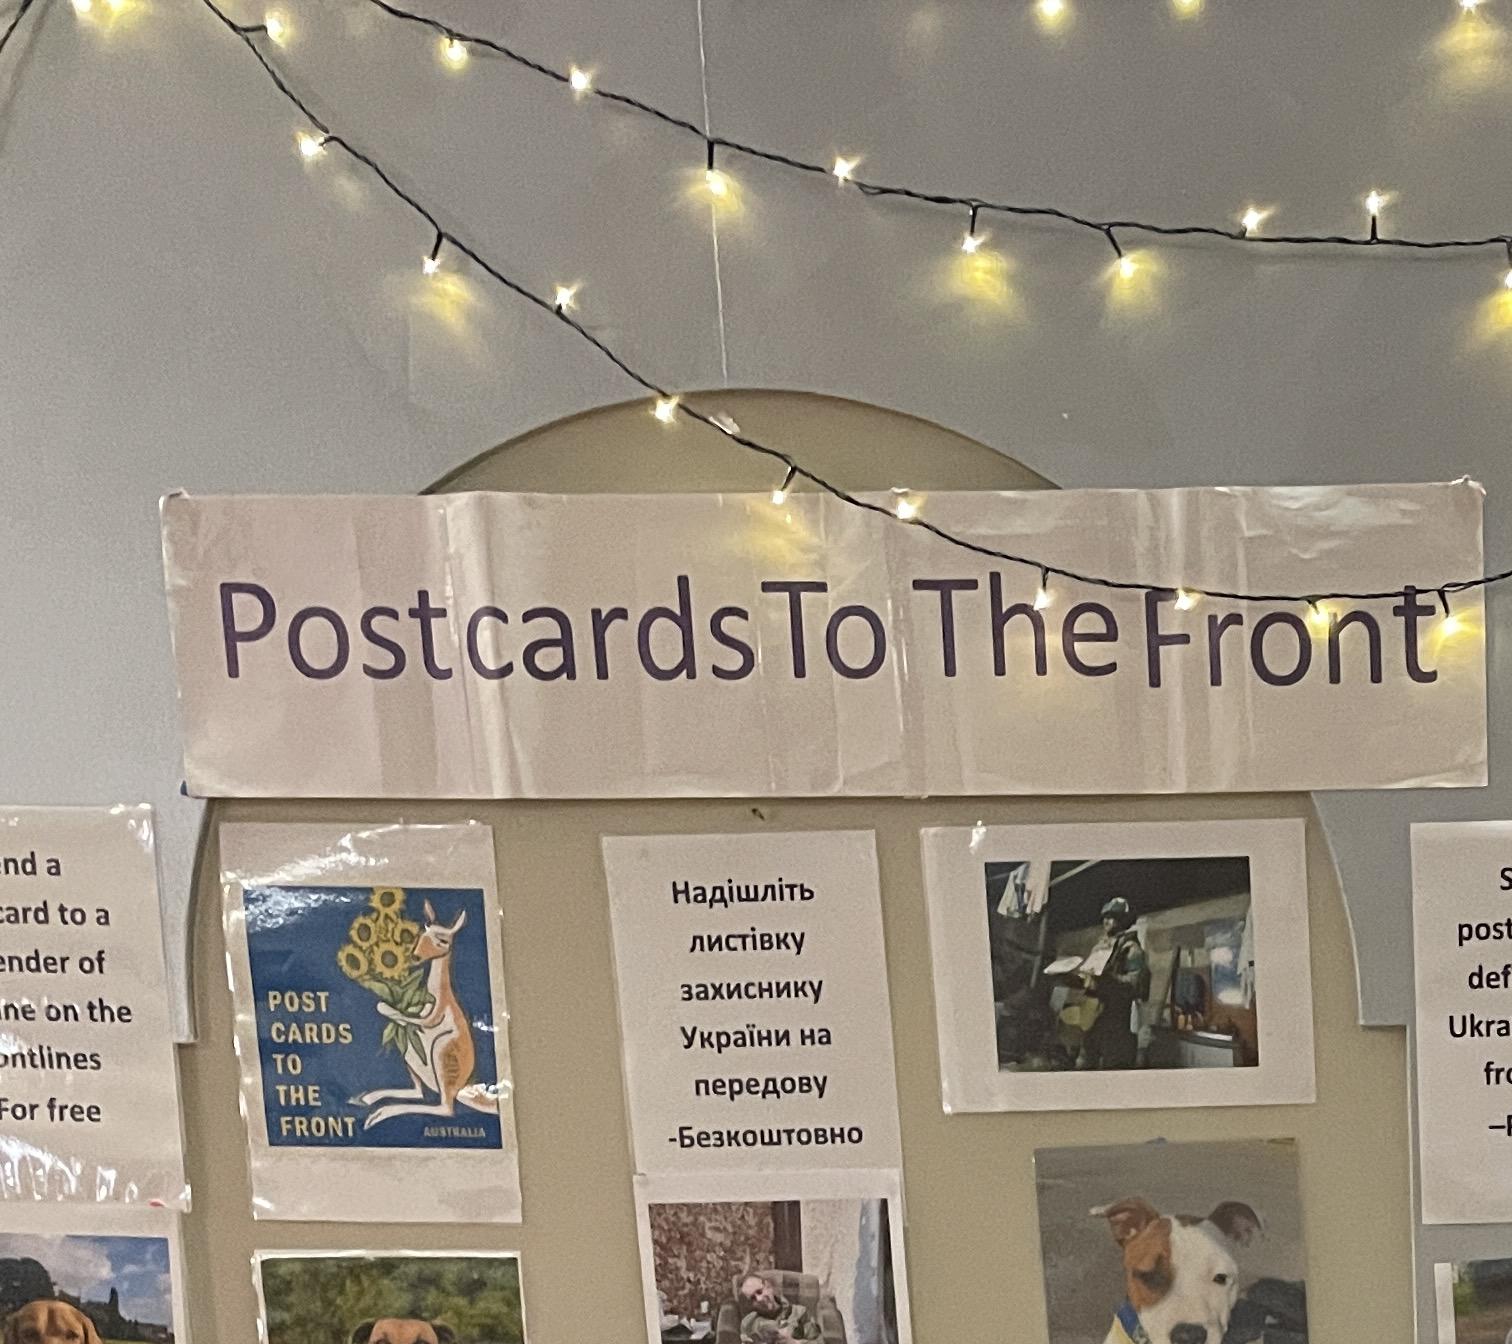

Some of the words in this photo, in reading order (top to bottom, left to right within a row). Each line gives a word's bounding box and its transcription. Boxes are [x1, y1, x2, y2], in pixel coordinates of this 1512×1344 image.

[912, 572, 1119, 678] The
[1144, 585, 1439, 689] Front
[46, 858, 62, 877] a
[671, 877, 815, 909] Надішліть
[58, 903, 87, 926] to
[96, 908, 110, 926] a
[689, 926, 806, 956] листівку
[78, 950, 105, 975] of
[267, 991, 330, 1013] POST
[680, 979, 823, 1005] захиснику
[45, 1003, 79, 1022] on
[87, 998, 132, 1023] the
[271, 1023, 353, 1046] CARDS
[680, 1023, 791, 1055] України
[800, 1027, 832, 1046] на
[272, 1053, 303, 1075] TO
[276, 1084, 322, 1107] THE
[694, 1075, 828, 1102] передову
[47, 1098, 101, 1122] free
[280, 1115, 356, 1139] FRONT
[668, 1125, 863, 1149] -Безкоштовно
